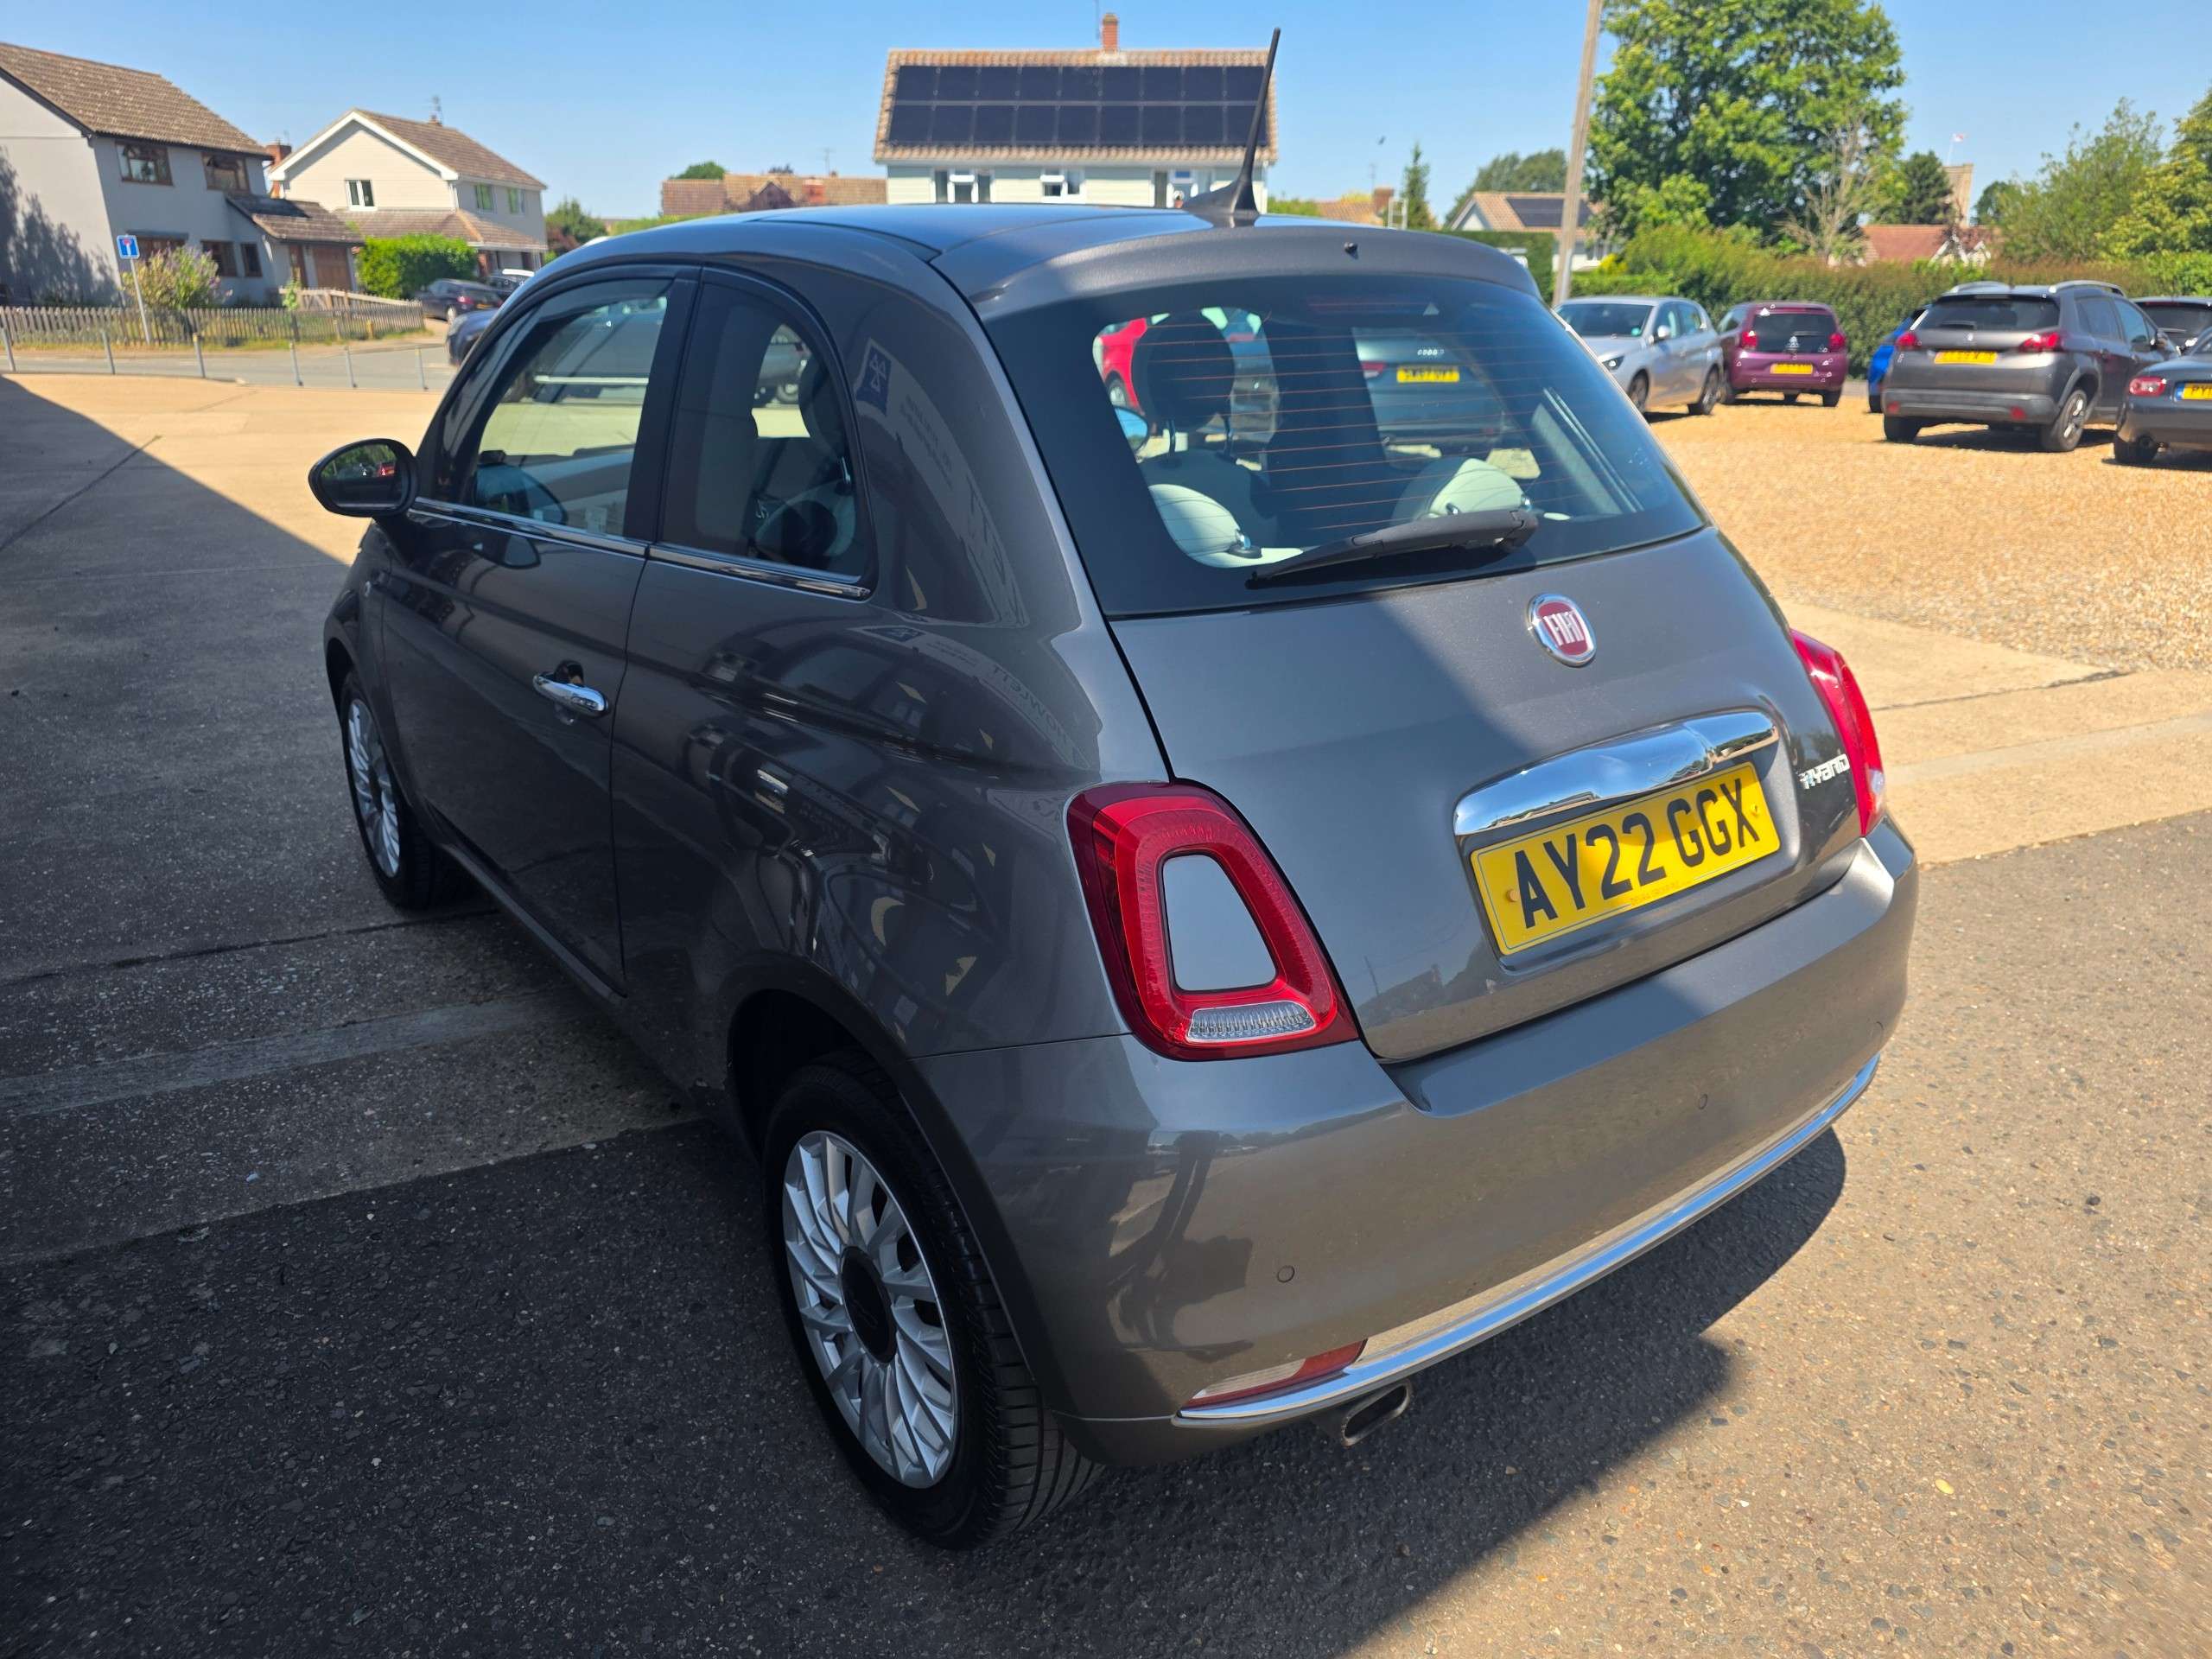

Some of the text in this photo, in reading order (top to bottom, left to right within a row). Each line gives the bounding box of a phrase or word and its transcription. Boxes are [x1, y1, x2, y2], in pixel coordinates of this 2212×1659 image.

[1541, 608, 1586, 647] FIAT
[1514, 779, 1759, 929] AY22 GGX
